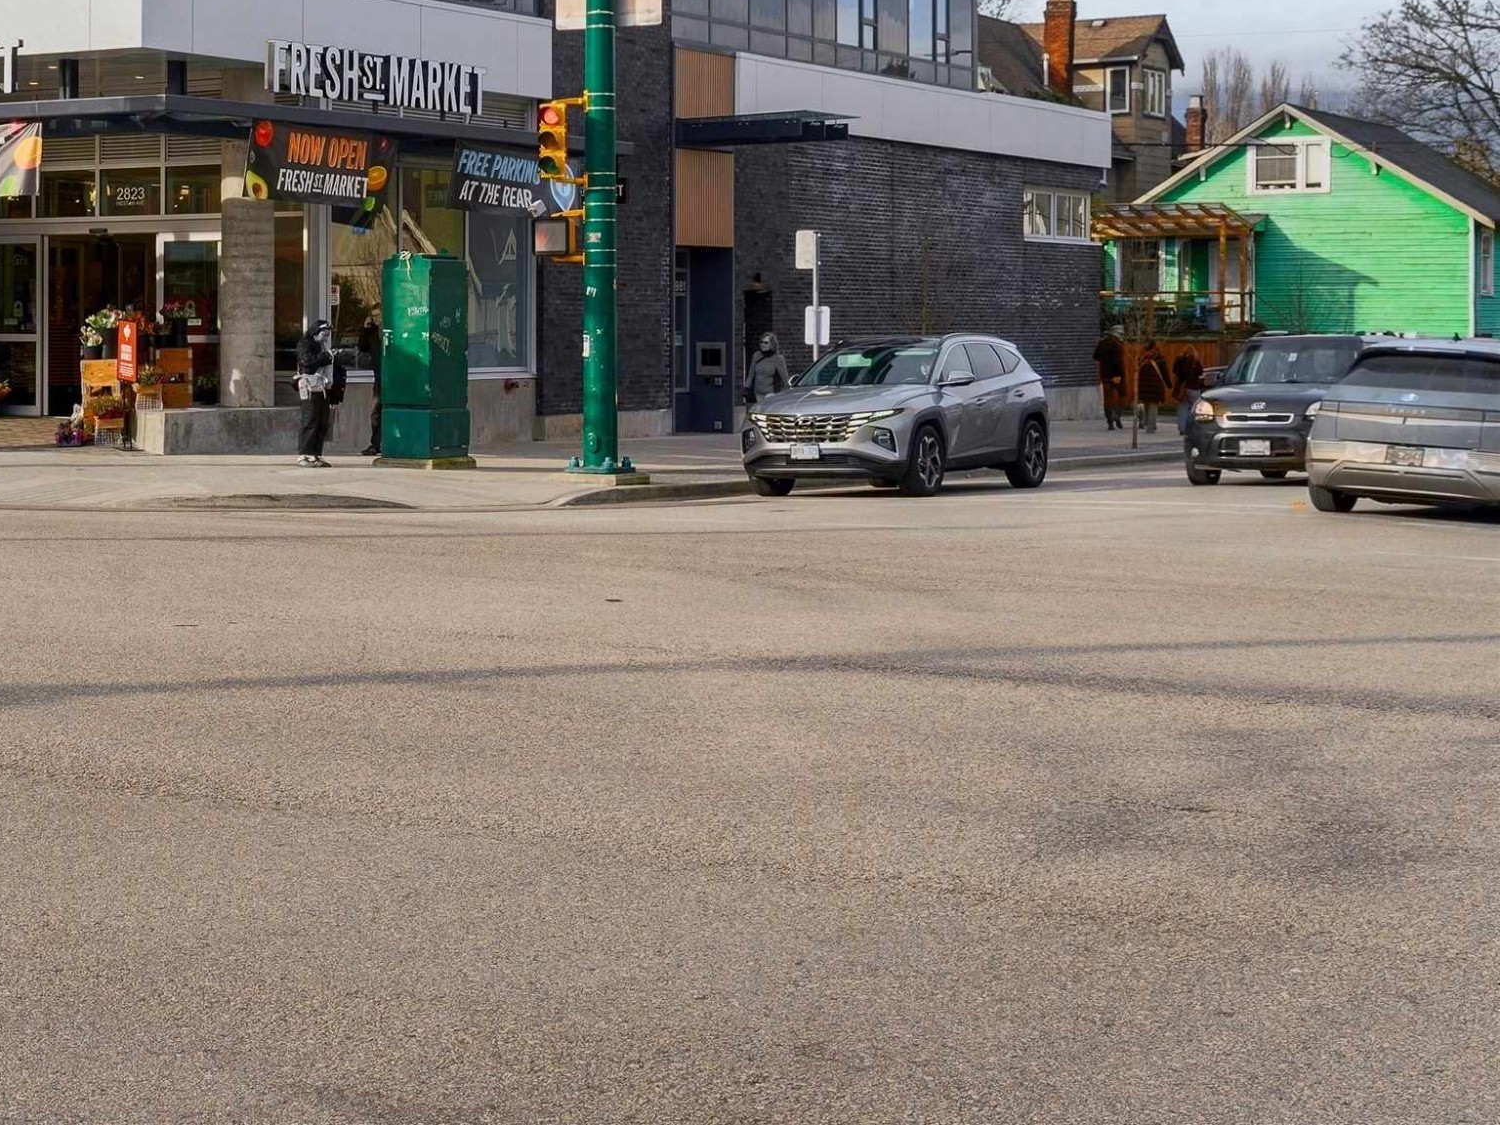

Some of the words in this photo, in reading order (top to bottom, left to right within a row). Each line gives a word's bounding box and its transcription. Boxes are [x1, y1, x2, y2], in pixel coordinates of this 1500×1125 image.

[273, 40, 359, 102] FRESH
[363, 55, 385, 90] ST.
[389, 55, 487, 116] MARKET
[287, 132, 326, 165] NOW
[329, 136, 368, 171] OPEN
[457, 149, 489, 176] FREE
[116, 187, 145, 200] 2823
[276, 168, 313, 193] FRESH
[323, 175, 369, 199] MARKET
[459, 179, 473, 201] AT
[477, 181, 501, 205] THE
[502, 185, 534, 208] REAR
